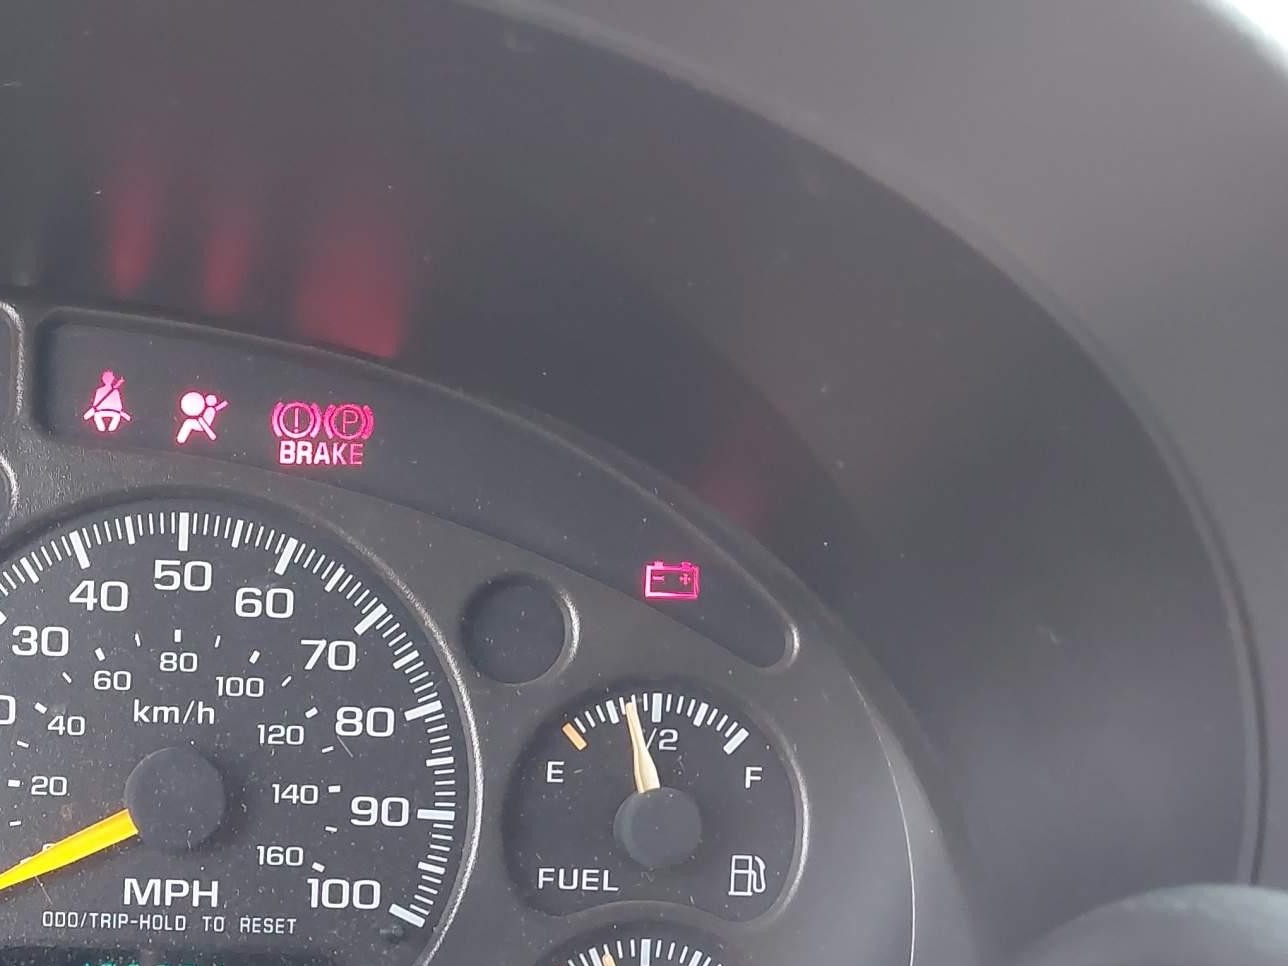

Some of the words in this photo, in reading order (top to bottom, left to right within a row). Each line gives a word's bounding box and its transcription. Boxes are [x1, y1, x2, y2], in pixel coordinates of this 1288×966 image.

[279, 440, 364, 465] BRAKE
[153, 560, 212, 591] 50
[69, 580, 129, 612] 40
[235, 588, 294, 618] 60
[12, 626, 69, 657] 30
[159, 652, 198, 673] 80
[300, 639, 357, 671] 70
[93, 670, 131, 691] 60
[215, 676, 264, 697] 100
[133, 699, 215, 726] km/h
[335, 707, 394, 737] 80
[47, 715, 85, 736] 40
[257, 725, 304, 745] 120
[546, 761, 565, 783] E
[745, 766, 763, 789] F
[31, 776, 68, 797] 20
[272, 784, 319, 804] 140
[351, 797, 410, 827] 90
[257, 846, 304, 866] 160
[537, 867, 619, 891] FUEL
[123, 878, 218, 907] MPH
[307, 878, 381, 909] 100
[42, 911, 186, 931] ODO/TRIP-HOLD
[202, 915, 224, 933] TO
[240, 917, 296, 934] RESET
